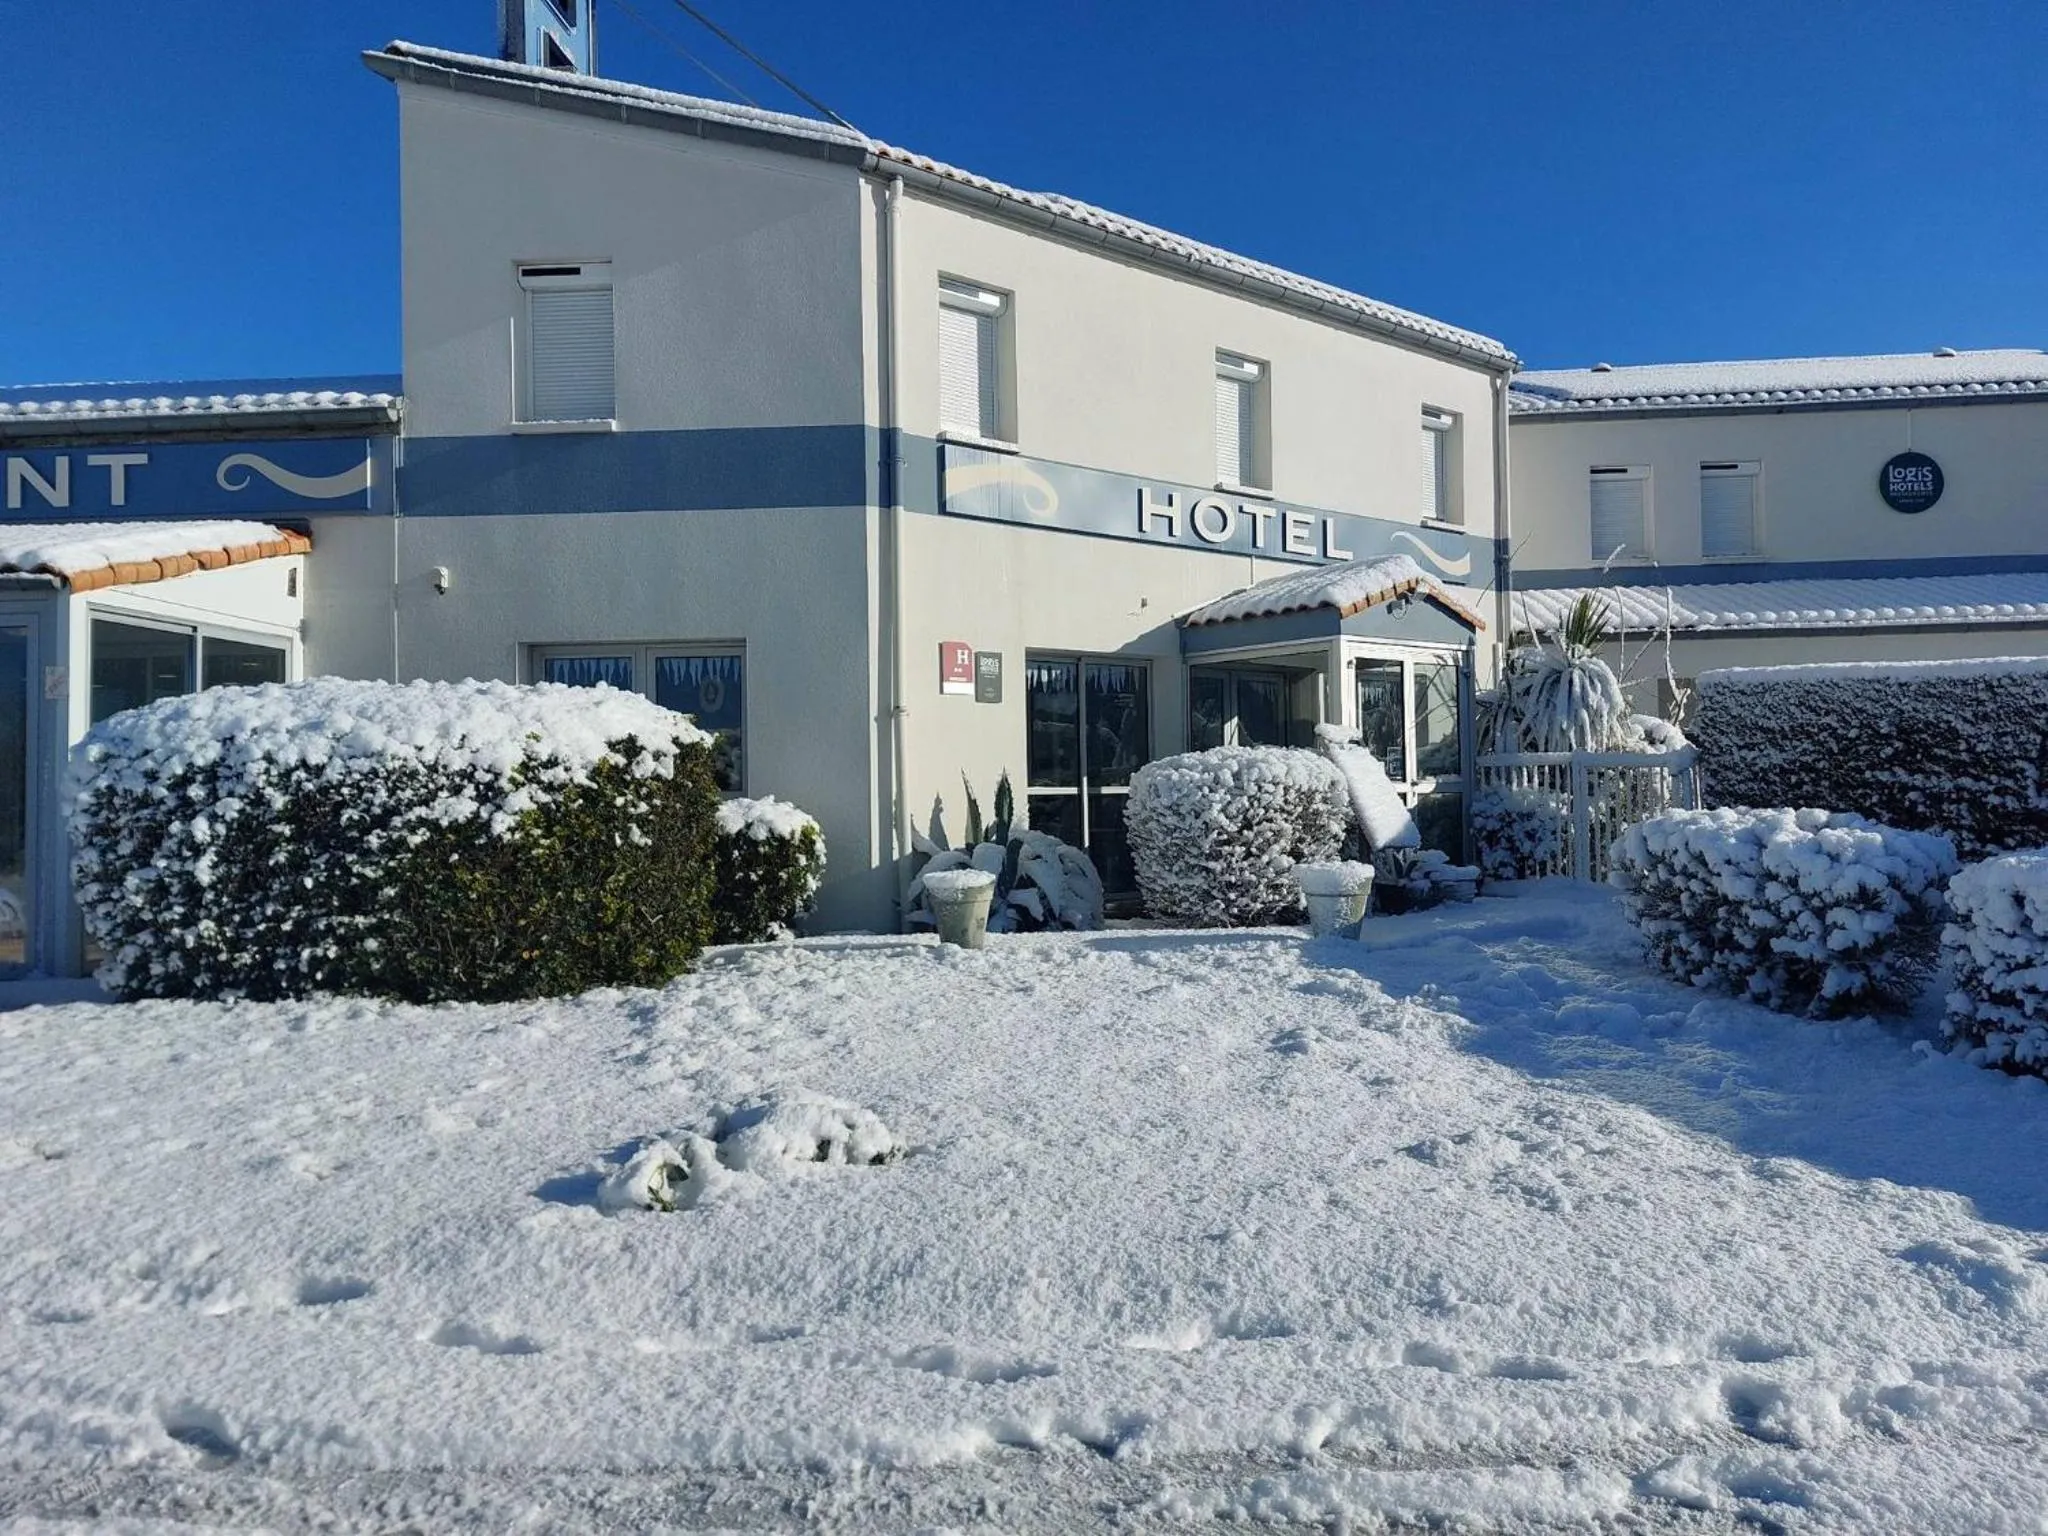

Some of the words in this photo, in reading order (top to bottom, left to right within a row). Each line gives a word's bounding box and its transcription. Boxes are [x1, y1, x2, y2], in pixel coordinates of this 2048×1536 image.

[6, 453, 149, 509] NT
[1889, 481, 1933, 491] HOTELS
[1137, 487, 1354, 561] HOTEL
[956, 649, 969, 665] H
